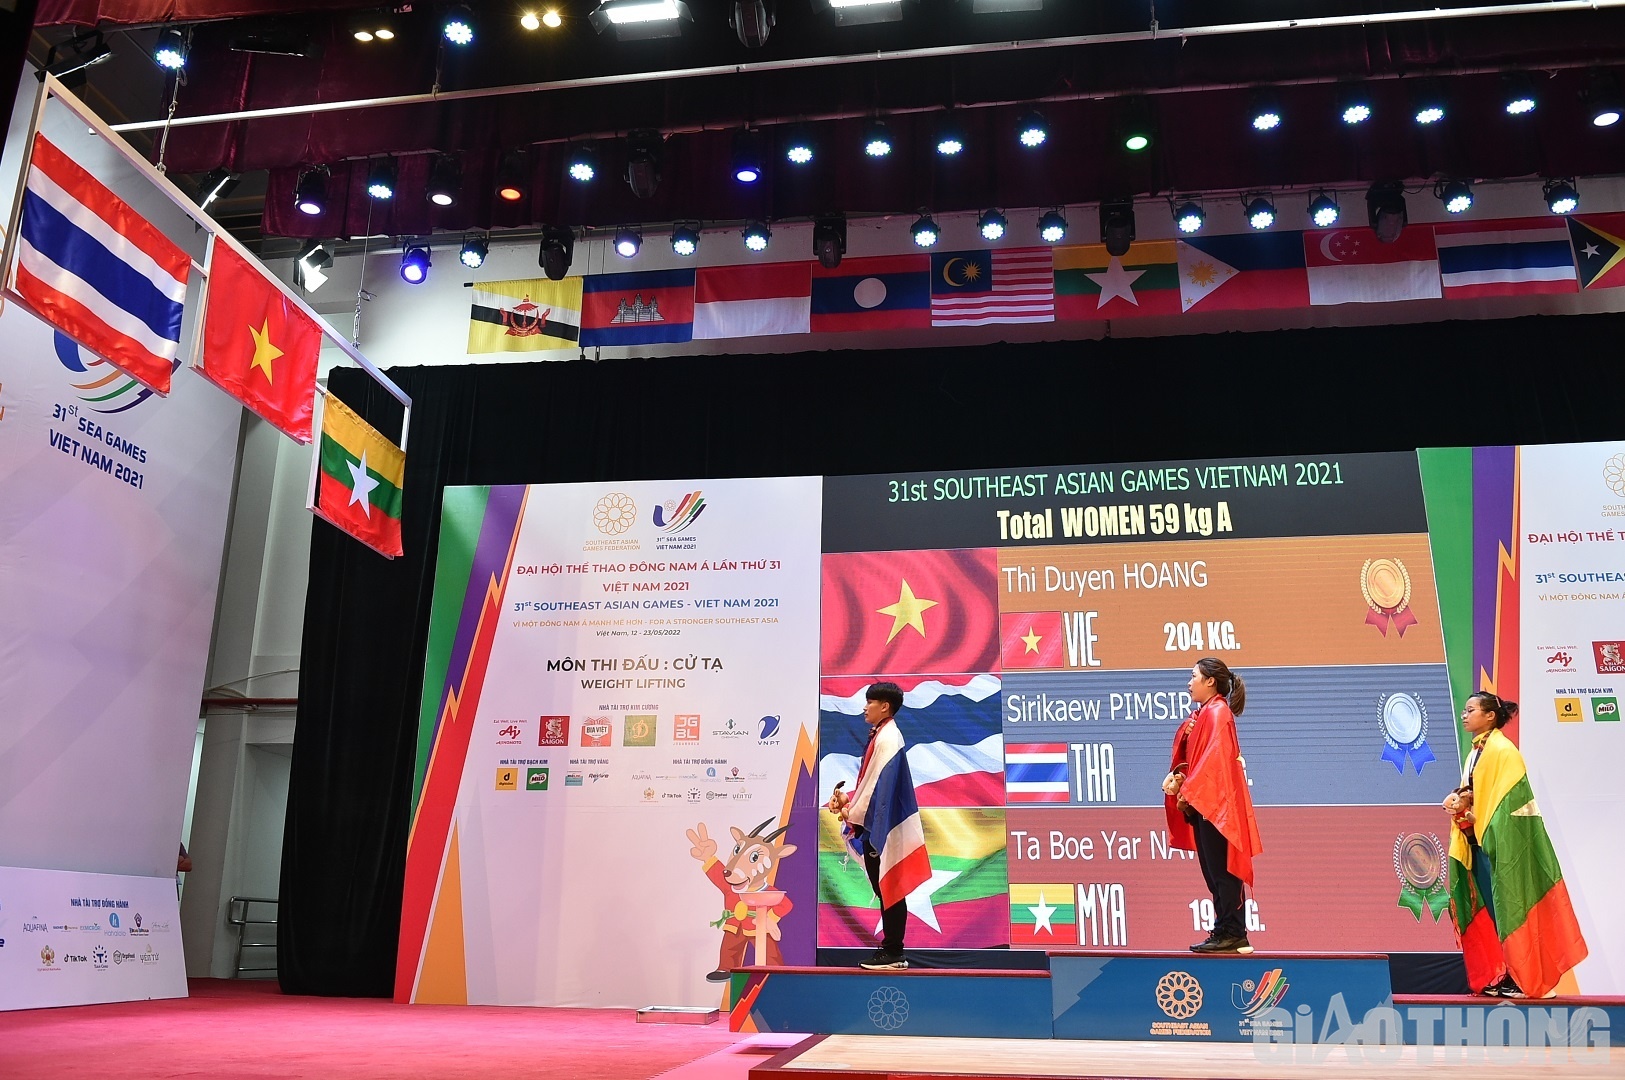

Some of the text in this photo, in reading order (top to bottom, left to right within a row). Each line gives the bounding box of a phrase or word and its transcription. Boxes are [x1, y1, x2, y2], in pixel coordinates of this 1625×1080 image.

[52, 403, 147, 463] 31st SEA GAMES
[49, 428, 144, 490] VIET NAM 2021
[888, 461, 1344, 502] 31st SOUTHEAST ASIAN GAMES VIETNAM 2021
[997, 501, 1233, 540] Total WOMEN 59 kg A
[1528, 533, 1553, 545] ĐẠI
[1557, 530, 1583, 544] HỘI
[1586, 528, 1615, 541] THỂ
[517, 565, 537, 576] ĐẠI
[541, 563, 562, 576] HỘI
[566, 561, 589, 573] THỂ
[592, 563, 625, 573] THAO
[629, 561, 665, 572] ĐÔNG
[669, 562, 697, 571] NAM
[701, 560, 709, 571] Á
[741, 559, 767, 570] THỨ
[769, 560, 781, 570] 31
[1002, 560, 1208, 598] Thi Duyen HOANG
[1535, 572, 1625, 583] 31st SOUTHEA
[602, 581, 689, 594] VIỆT NAM 2021
[1550, 593, 1568, 602] MỘT
[514, 598, 779, 611] 31st SOUTHEAST ASIAN GAMES VIET NAM 2021
[1063, 611, 1241, 667] VIE 204 KG.
[547, 653, 723, 673] MÔN THI ĐẤU CỬ TẠ
[581, 678, 686, 689] WEIGHT LIFTING
[1006, 692, 1200, 722] Sirikaew PIMSIR
[596, 726, 607, 734] VIỆT
[1070, 743, 1117, 802] THA
[1010, 831, 1041, 860] Ta
[1050, 830, 1094, 860] Boe
[1100, 830, 1141, 860] Yar
[1077, 883, 1127, 946] MYA
[23, 923, 48, 932] AQUAFINA
